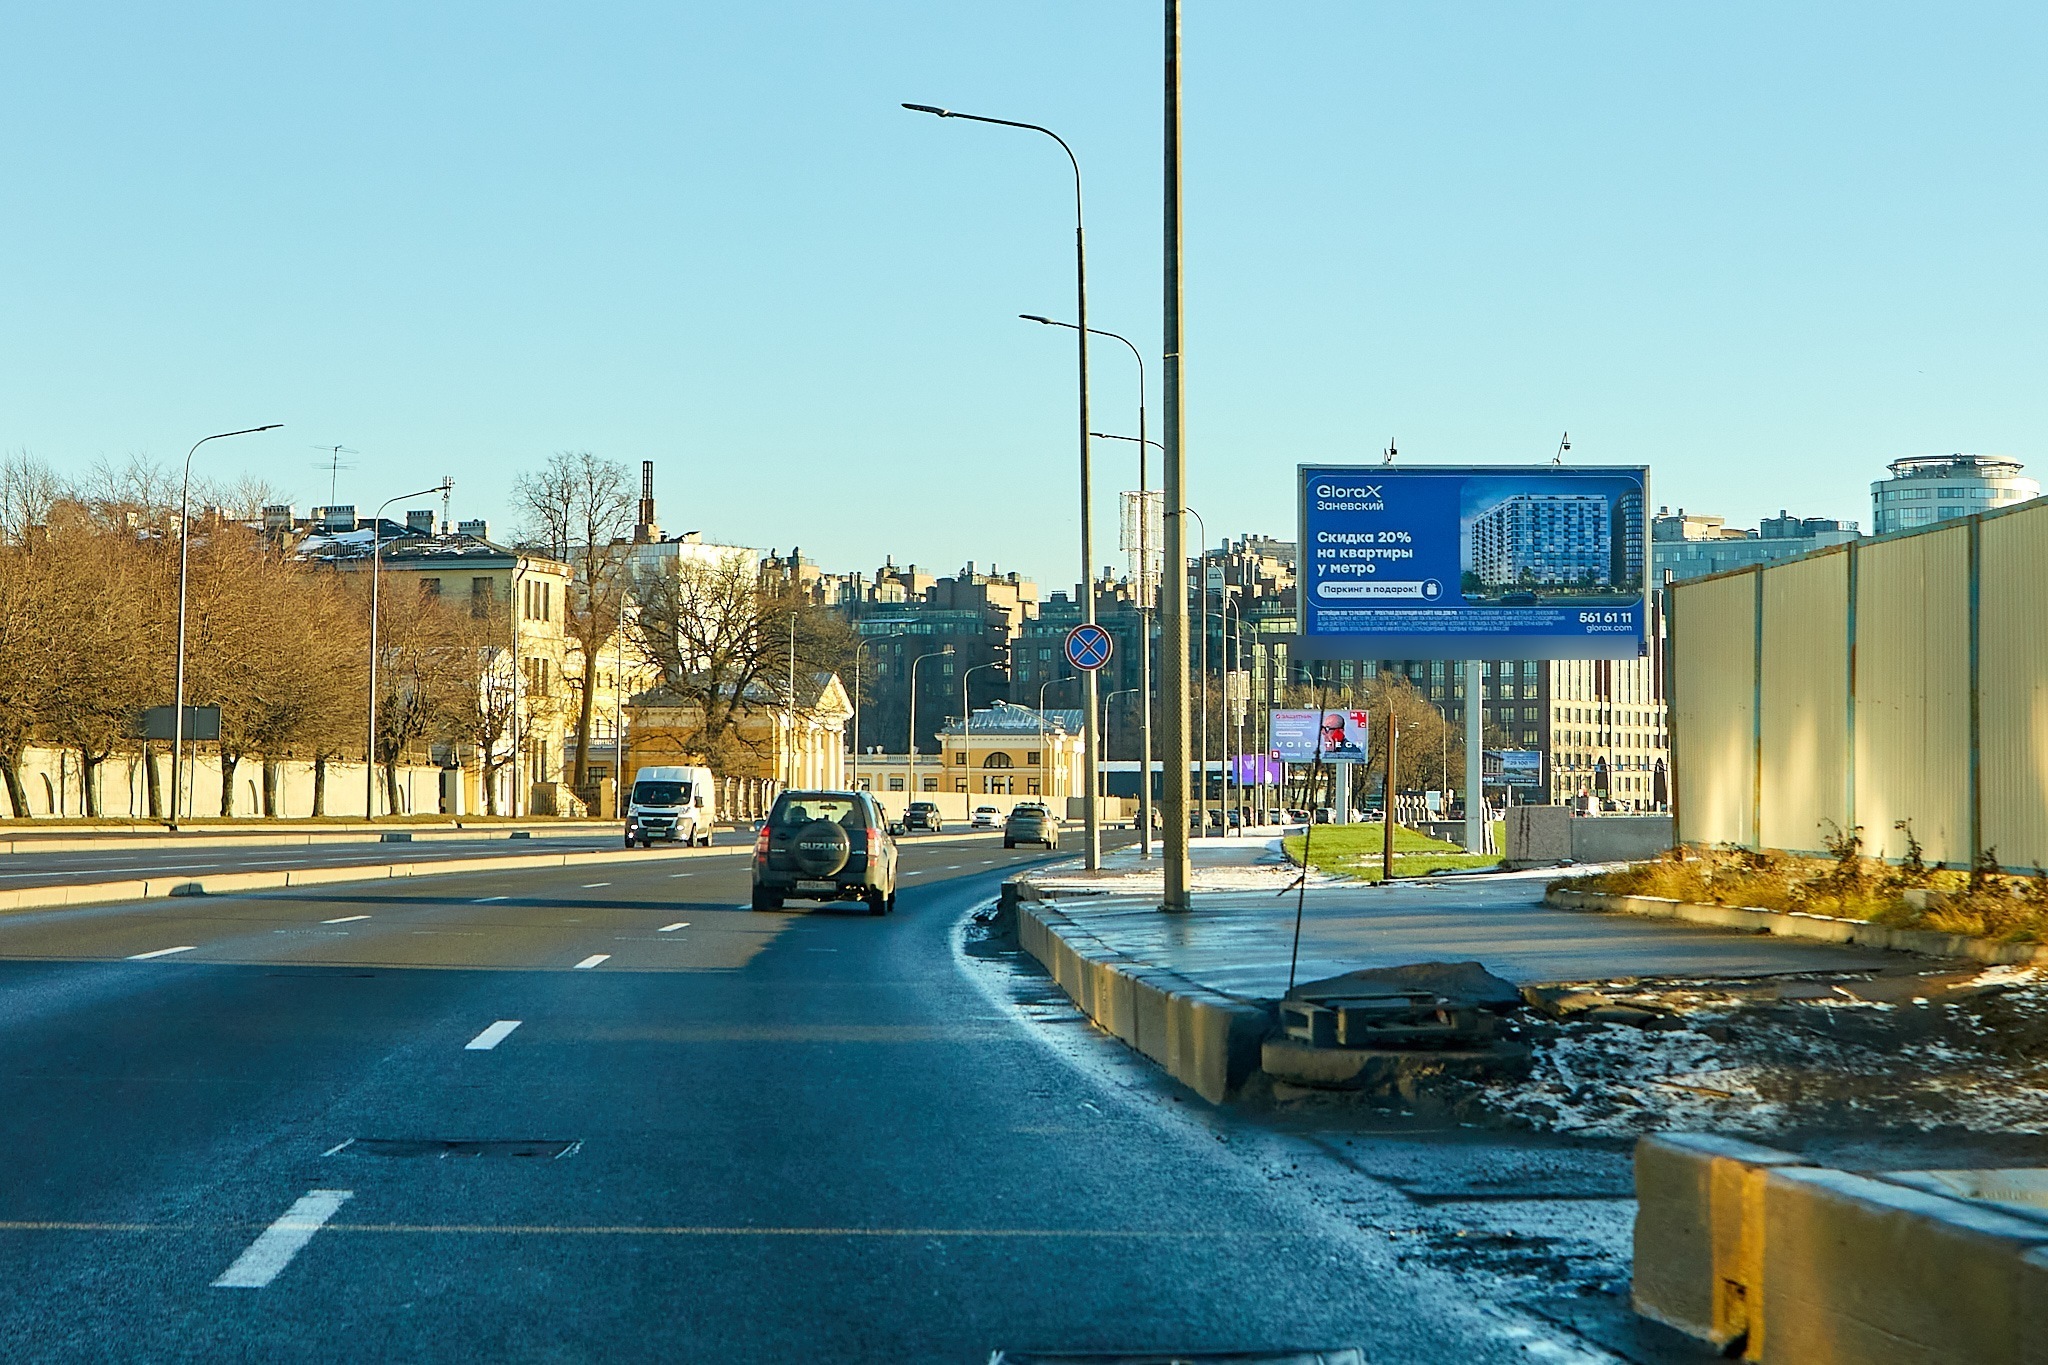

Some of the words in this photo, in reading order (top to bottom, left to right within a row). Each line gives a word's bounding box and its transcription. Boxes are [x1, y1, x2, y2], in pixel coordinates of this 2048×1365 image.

[1316, 485, 1383, 498] GloraX
[1317, 500, 1384, 511] Заневский
[1317, 531, 1374, 545] Скидка
[1377, 531, 1412, 543] 20%
[1317, 548, 1336, 559] на
[1339, 548, 1413, 562] квартиры
[1317, 563, 1327, 577] у
[1330, 564, 1376, 577] метро
[1323, 586, 1364, 595] Паркинг
[1373, 586, 1418, 595] подарок!
[1579, 612, 1601, 623] 561
[1604, 612, 1618, 623] 61
[1620, 612, 1632, 623] 11
[1586, 624, 1633, 634] glorax.com
[799, 842, 844, 851] SUZUKI
